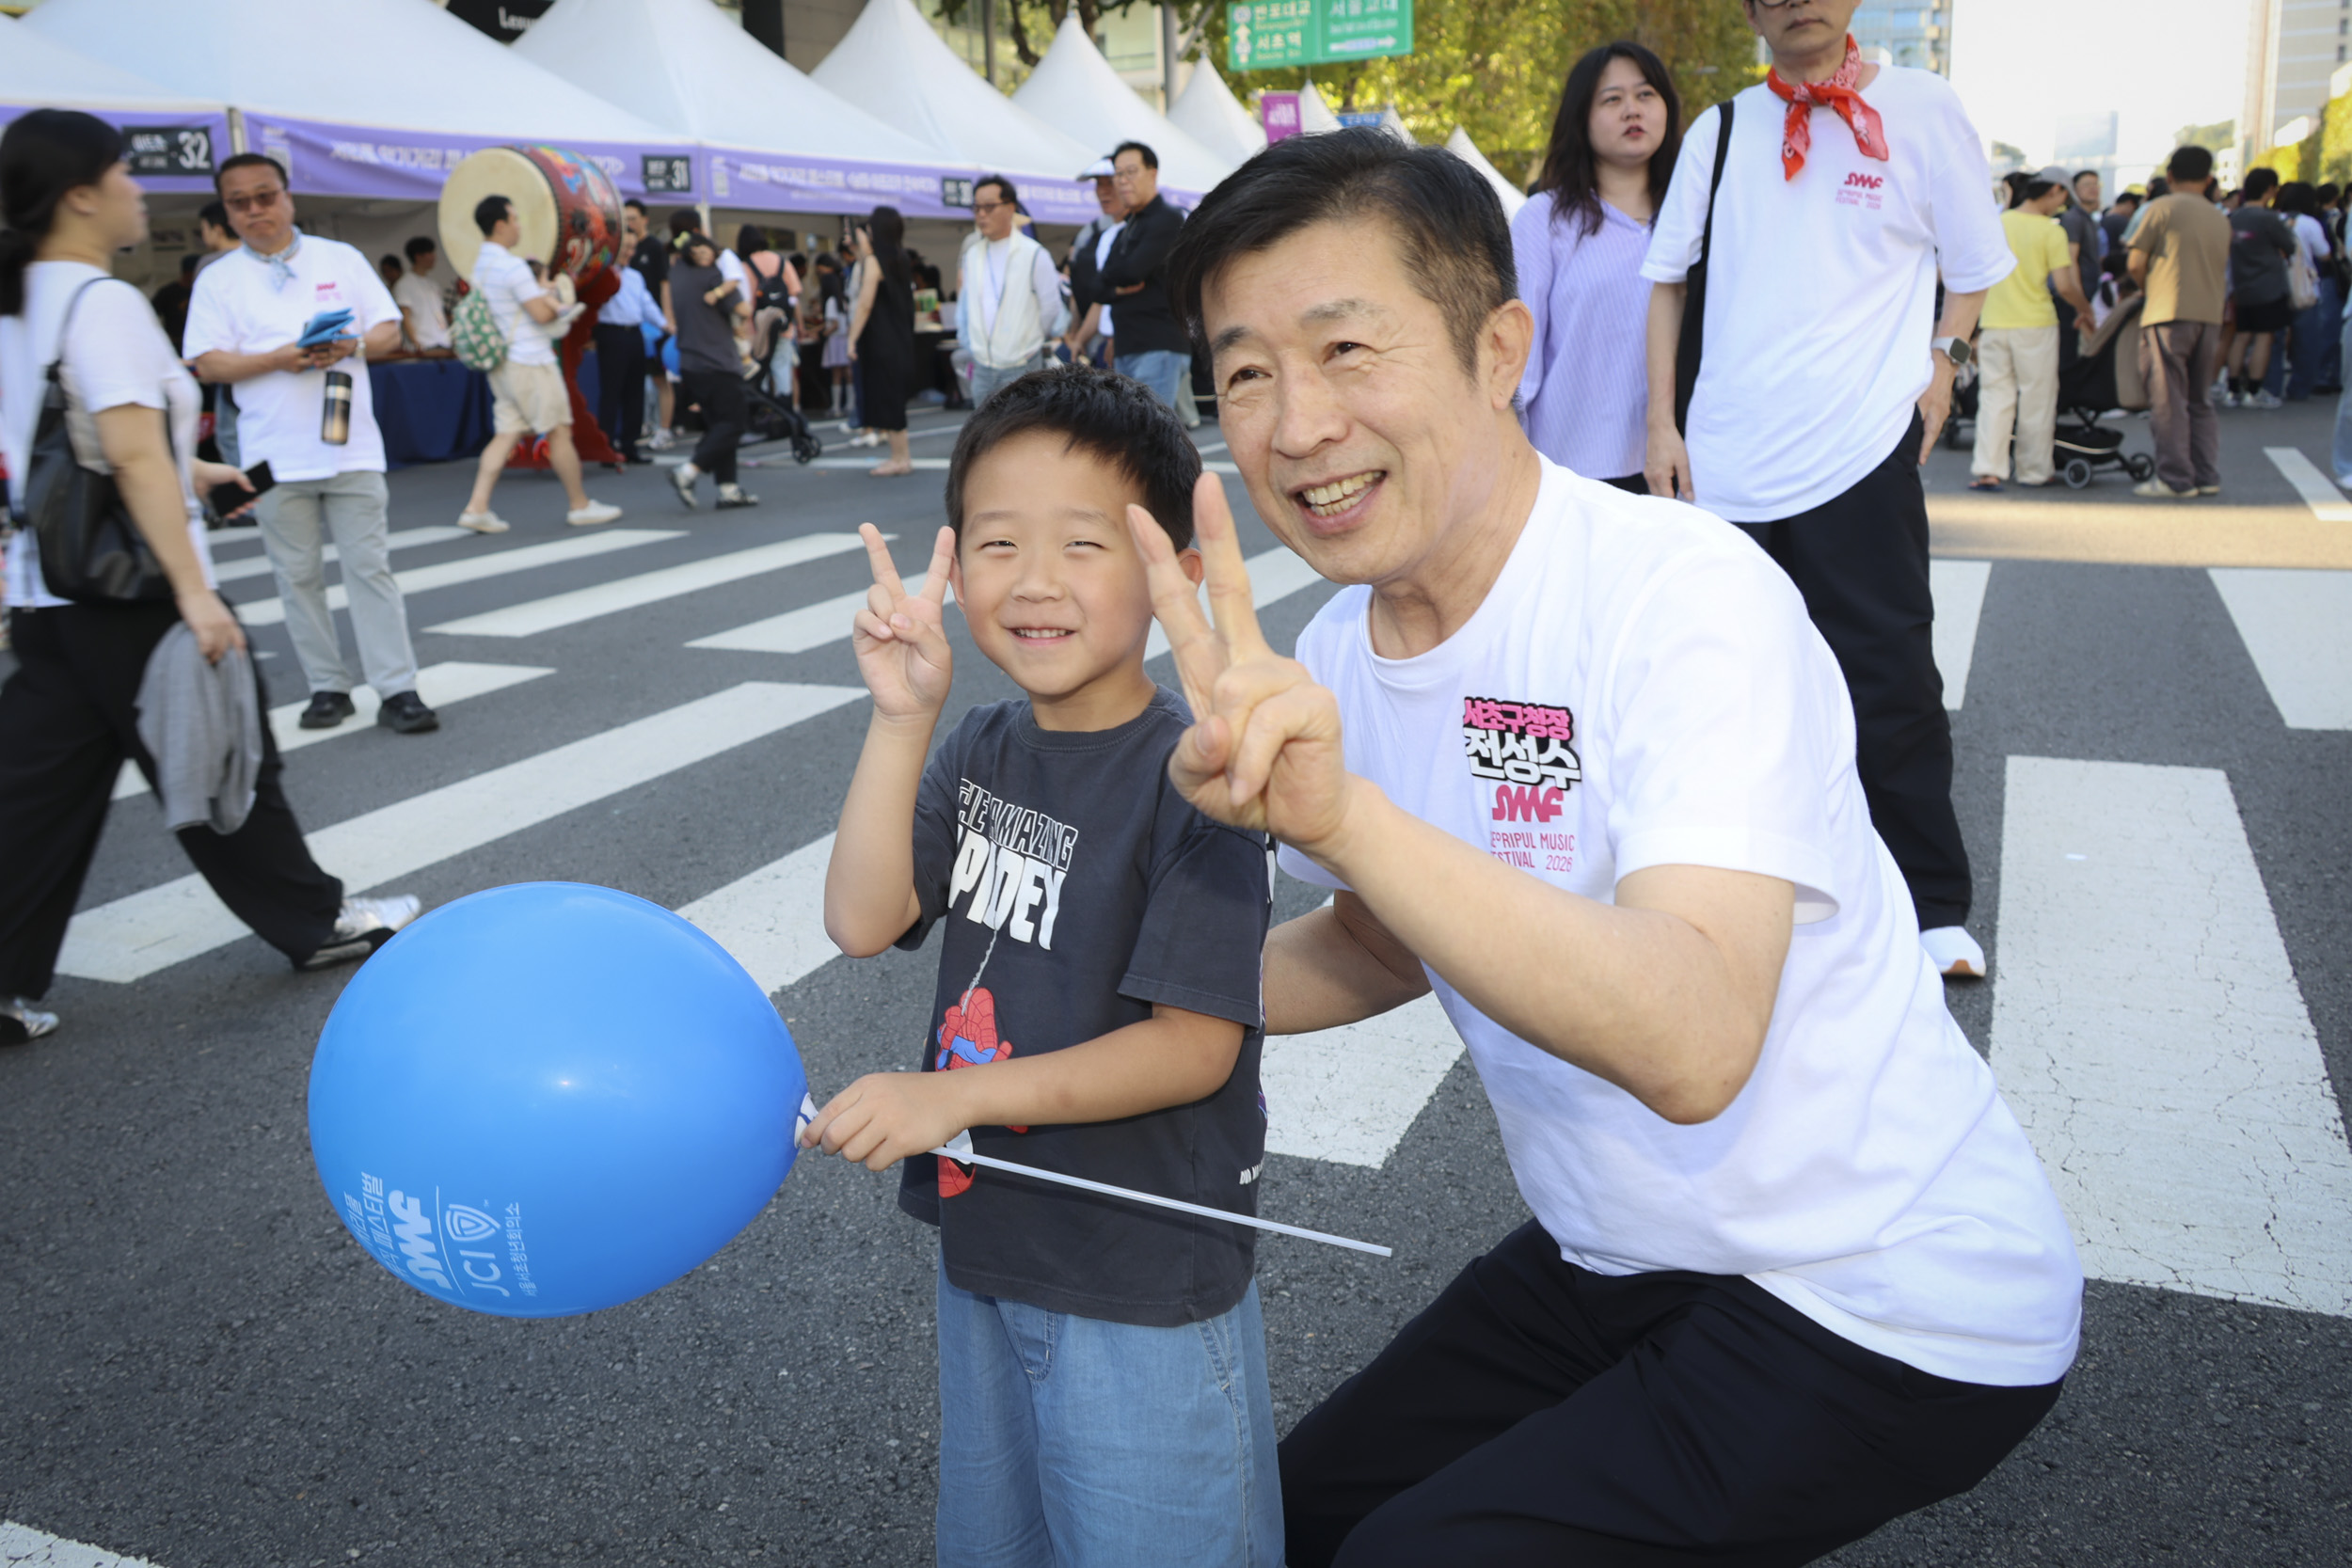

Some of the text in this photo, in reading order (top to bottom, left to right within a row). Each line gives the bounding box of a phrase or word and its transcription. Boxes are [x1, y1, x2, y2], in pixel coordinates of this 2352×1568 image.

[1255, 1, 1311, 20] 반포대교
[1329, 0, 1398, 16] 서울교대
[1256, 31, 1301, 49] 서초역
[178, 131, 212, 169] 32
[671, 159, 689, 189] 31
[1464, 699, 1572, 742] 서초구청장
[1463, 727, 1581, 789] 전성수
[989, 797, 1079, 872] AMAZING
[1490, 831, 1575, 851] EORIPUL MUSIC
[1490, 850, 1535, 868] STIVAL
[947, 823, 1068, 950] PIDEY
[361, 1171, 394, 1250] 페스티벌
[459, 1249, 510, 1297] JCI
